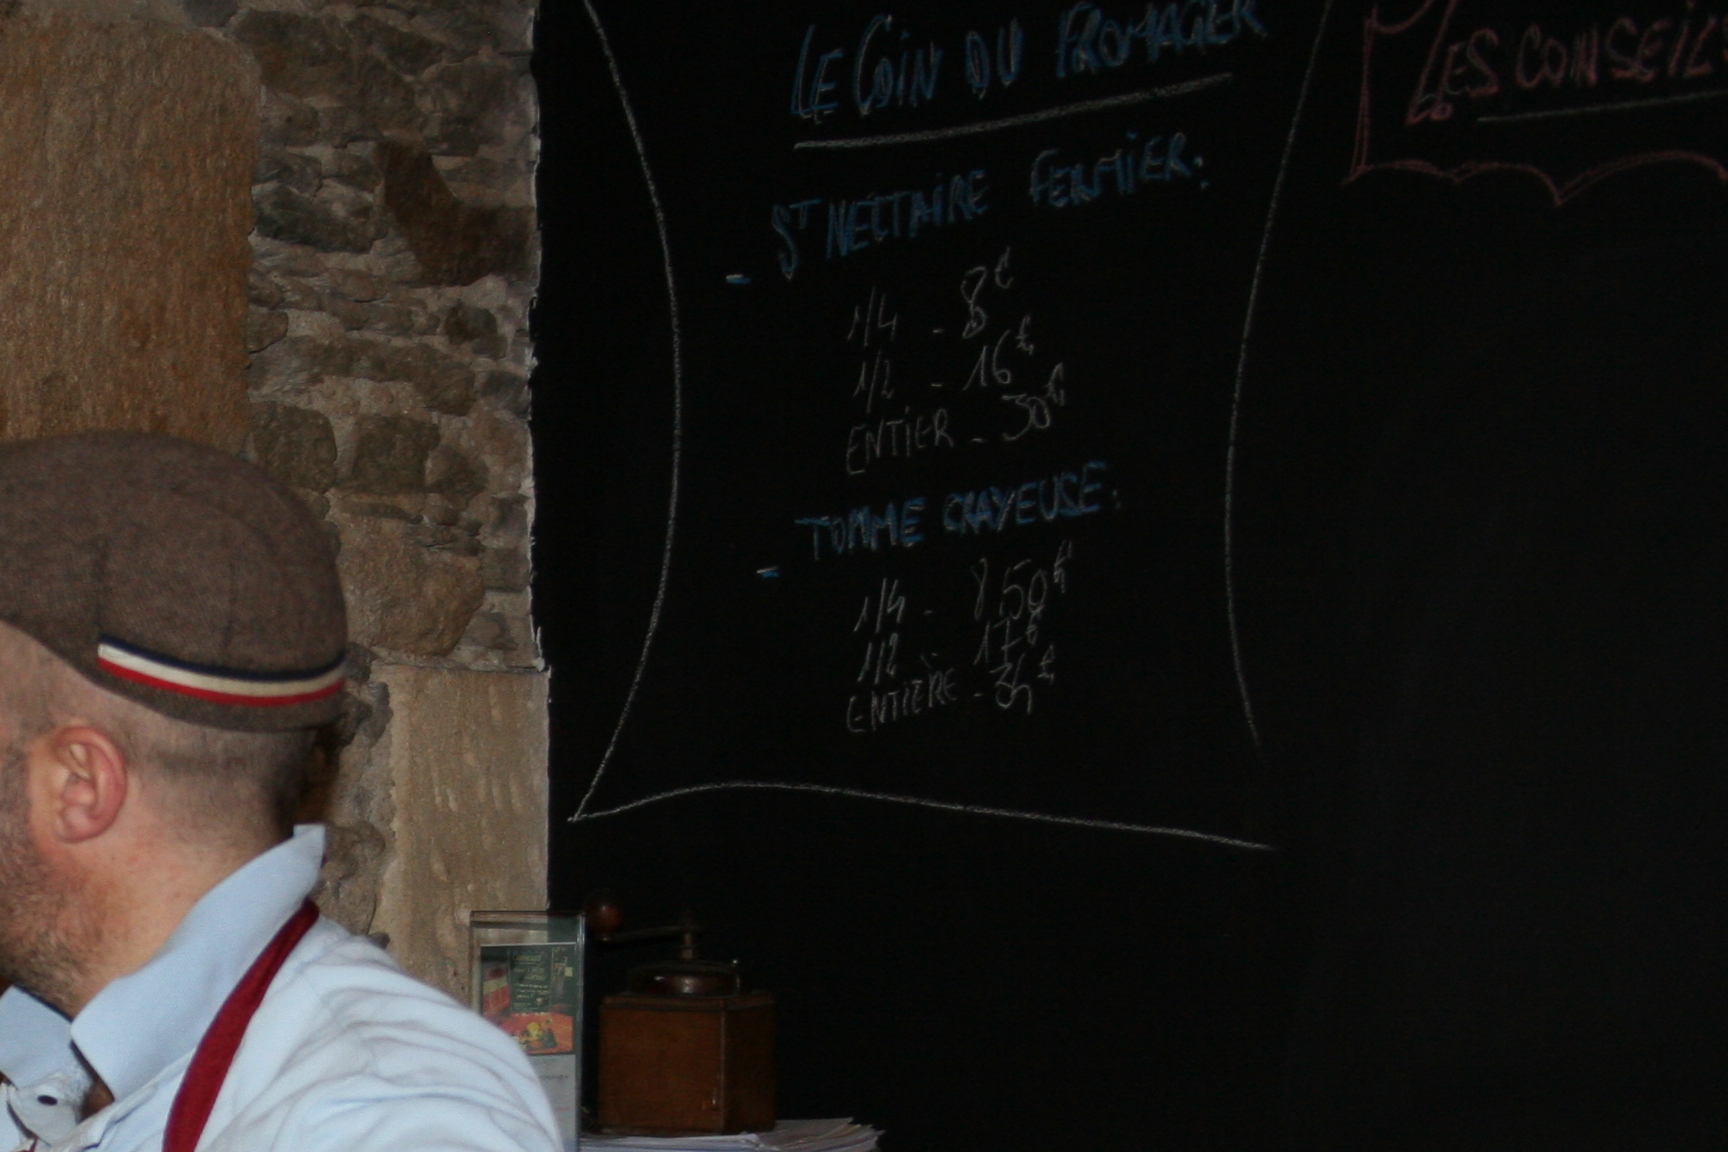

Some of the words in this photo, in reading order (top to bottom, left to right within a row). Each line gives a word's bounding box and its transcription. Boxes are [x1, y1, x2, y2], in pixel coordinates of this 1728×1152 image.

[790, 23, 846, 124] LE
[965, 16, 1024, 100] DU
[1404, 0, 1500, 125] LES
[1515, 0, 1728, 88] CONSEIL
[847, 285, 900, 348] 1/4
[853, 348, 896, 415] 1/2
[794, 495, 928, 562] TOMME
[854, 576, 907, 634] 1/4
[856, 631, 900, 686] 1/2
